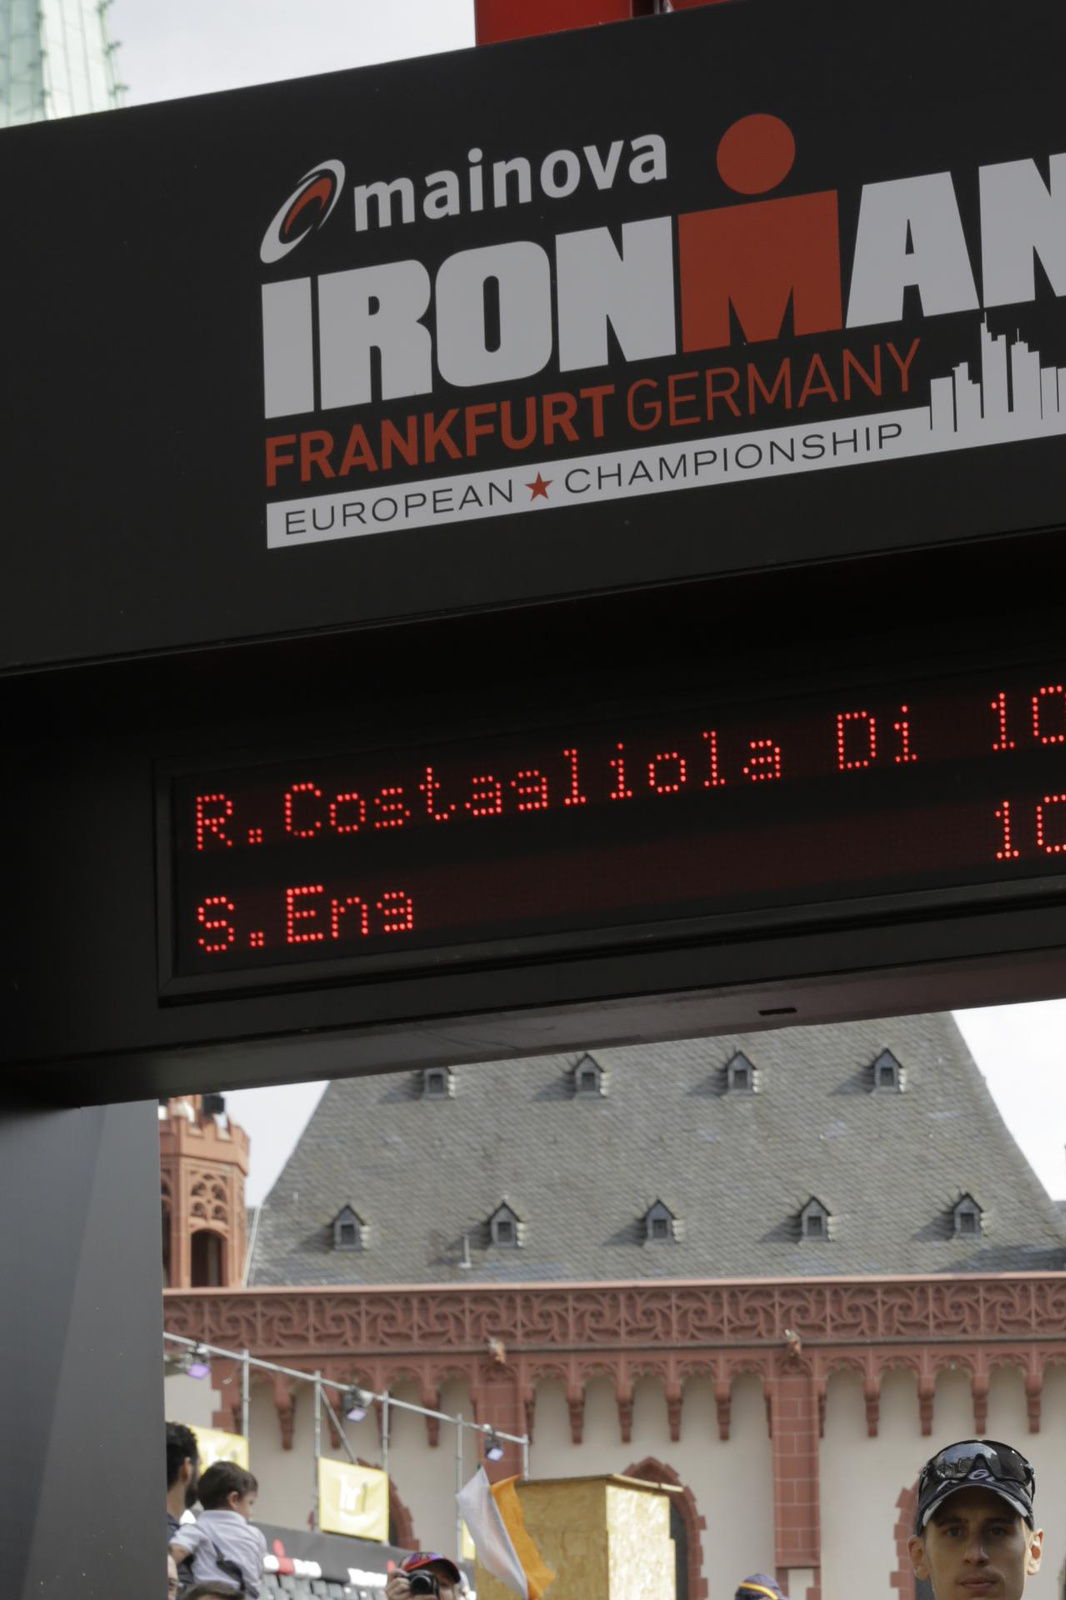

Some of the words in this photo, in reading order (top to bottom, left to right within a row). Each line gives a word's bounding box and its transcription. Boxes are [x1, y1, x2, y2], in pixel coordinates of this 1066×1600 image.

[353, 132, 669, 233] mainova
[264, 384, 615, 487] FRANKFURT
[625, 338, 921, 432] GERMANY
[283, 479, 515, 537] EUROPEAN
[564, 421, 904, 496] CHAMPIONSHIP
[836, 704, 918, 770] Di
